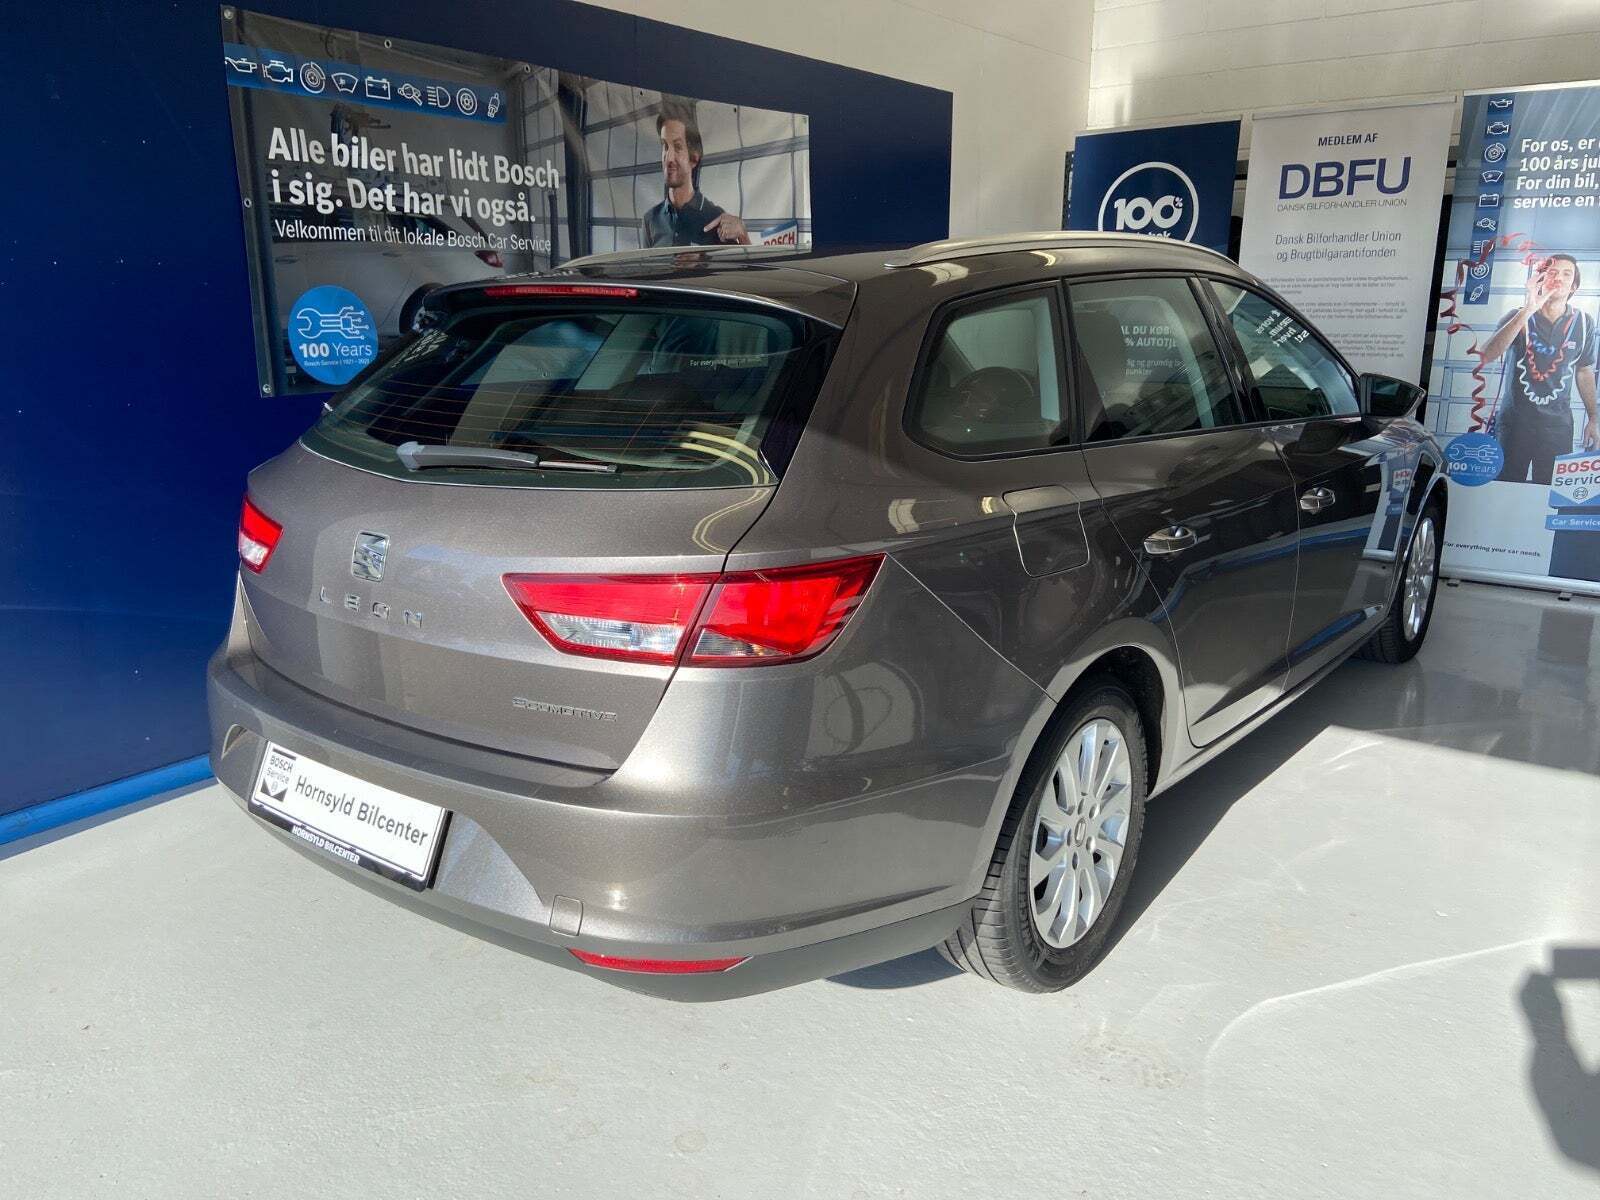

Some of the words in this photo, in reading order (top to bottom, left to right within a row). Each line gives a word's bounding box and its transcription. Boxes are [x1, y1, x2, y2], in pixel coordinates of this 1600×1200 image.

[1318, 134, 1362, 146] MEDLEM
[1364, 132, 1379, 144] AF
[1521, 138, 1548, 153] For
[1551, 139, 1574, 153] os,
[1578, 138, 1596, 150] er
[268, 127, 326, 164] Alle
[331, 132, 397, 172] biler
[401, 142, 444, 177] har
[448, 148, 490, 182] lidt
[494, 155, 560, 189] Bosch
[1520, 156, 1551, 172] 100
[1553, 155, 1579, 170] års
[1278, 156, 1412, 200] DBFU
[1516, 175, 1543, 190] For
[1545, 173, 1571, 190] din
[1574, 172, 1600, 190] bil,
[271, 169, 281, 203] i
[289, 171, 343, 214] sig.
[347, 177, 397, 212] Det
[404, 182, 445, 216] har
[450, 188, 472, 218] vi
[477, 191, 536, 227] også.
[1276, 203, 1305, 212] DANSK
[1306, 200, 1377, 211] BILFORHANDLER
[1378, 199, 1408, 207] UNION
[1513, 193, 1572, 209] service
[1574, 195, 1595, 208] en
[275, 219, 365, 241] Velkommen
[368, 224, 383, 242] til
[384, 225, 401, 244] dit
[403, 226, 444, 247] lokale
[447, 230, 486, 248] Bosch
[488, 232, 508, 250] Car
[510, 233, 552, 252] Service
[1275, 234, 1304, 245] Dansk
[1306, 231, 1369, 244] Bilforhandler
[1371, 231, 1402, 241] Union
[1276, 252, 1288, 262] og
[1290, 247, 1396, 261] Brugtbilgarantifonden
[299, 342, 330, 358] 100
[332, 342, 373, 357] Years
[1449, 462, 1468, 471] 100
[1471, 463, 1497, 474] Years
[1551, 518, 1567, 527] Car
[1456, 543, 1490, 553] everything
[320, 585, 423, 629] LEON
[512, 697, 616, 722] ECOMOTIVE
[270, 755, 293, 773] BOSCH
[266, 767, 290, 785] Service
[295, 775, 355, 817] Hornsyld
[357, 802, 428, 847] Bilcenter
[292, 825, 325, 849] HORNSYLD
[324, 839, 361, 865] BILCENTER
